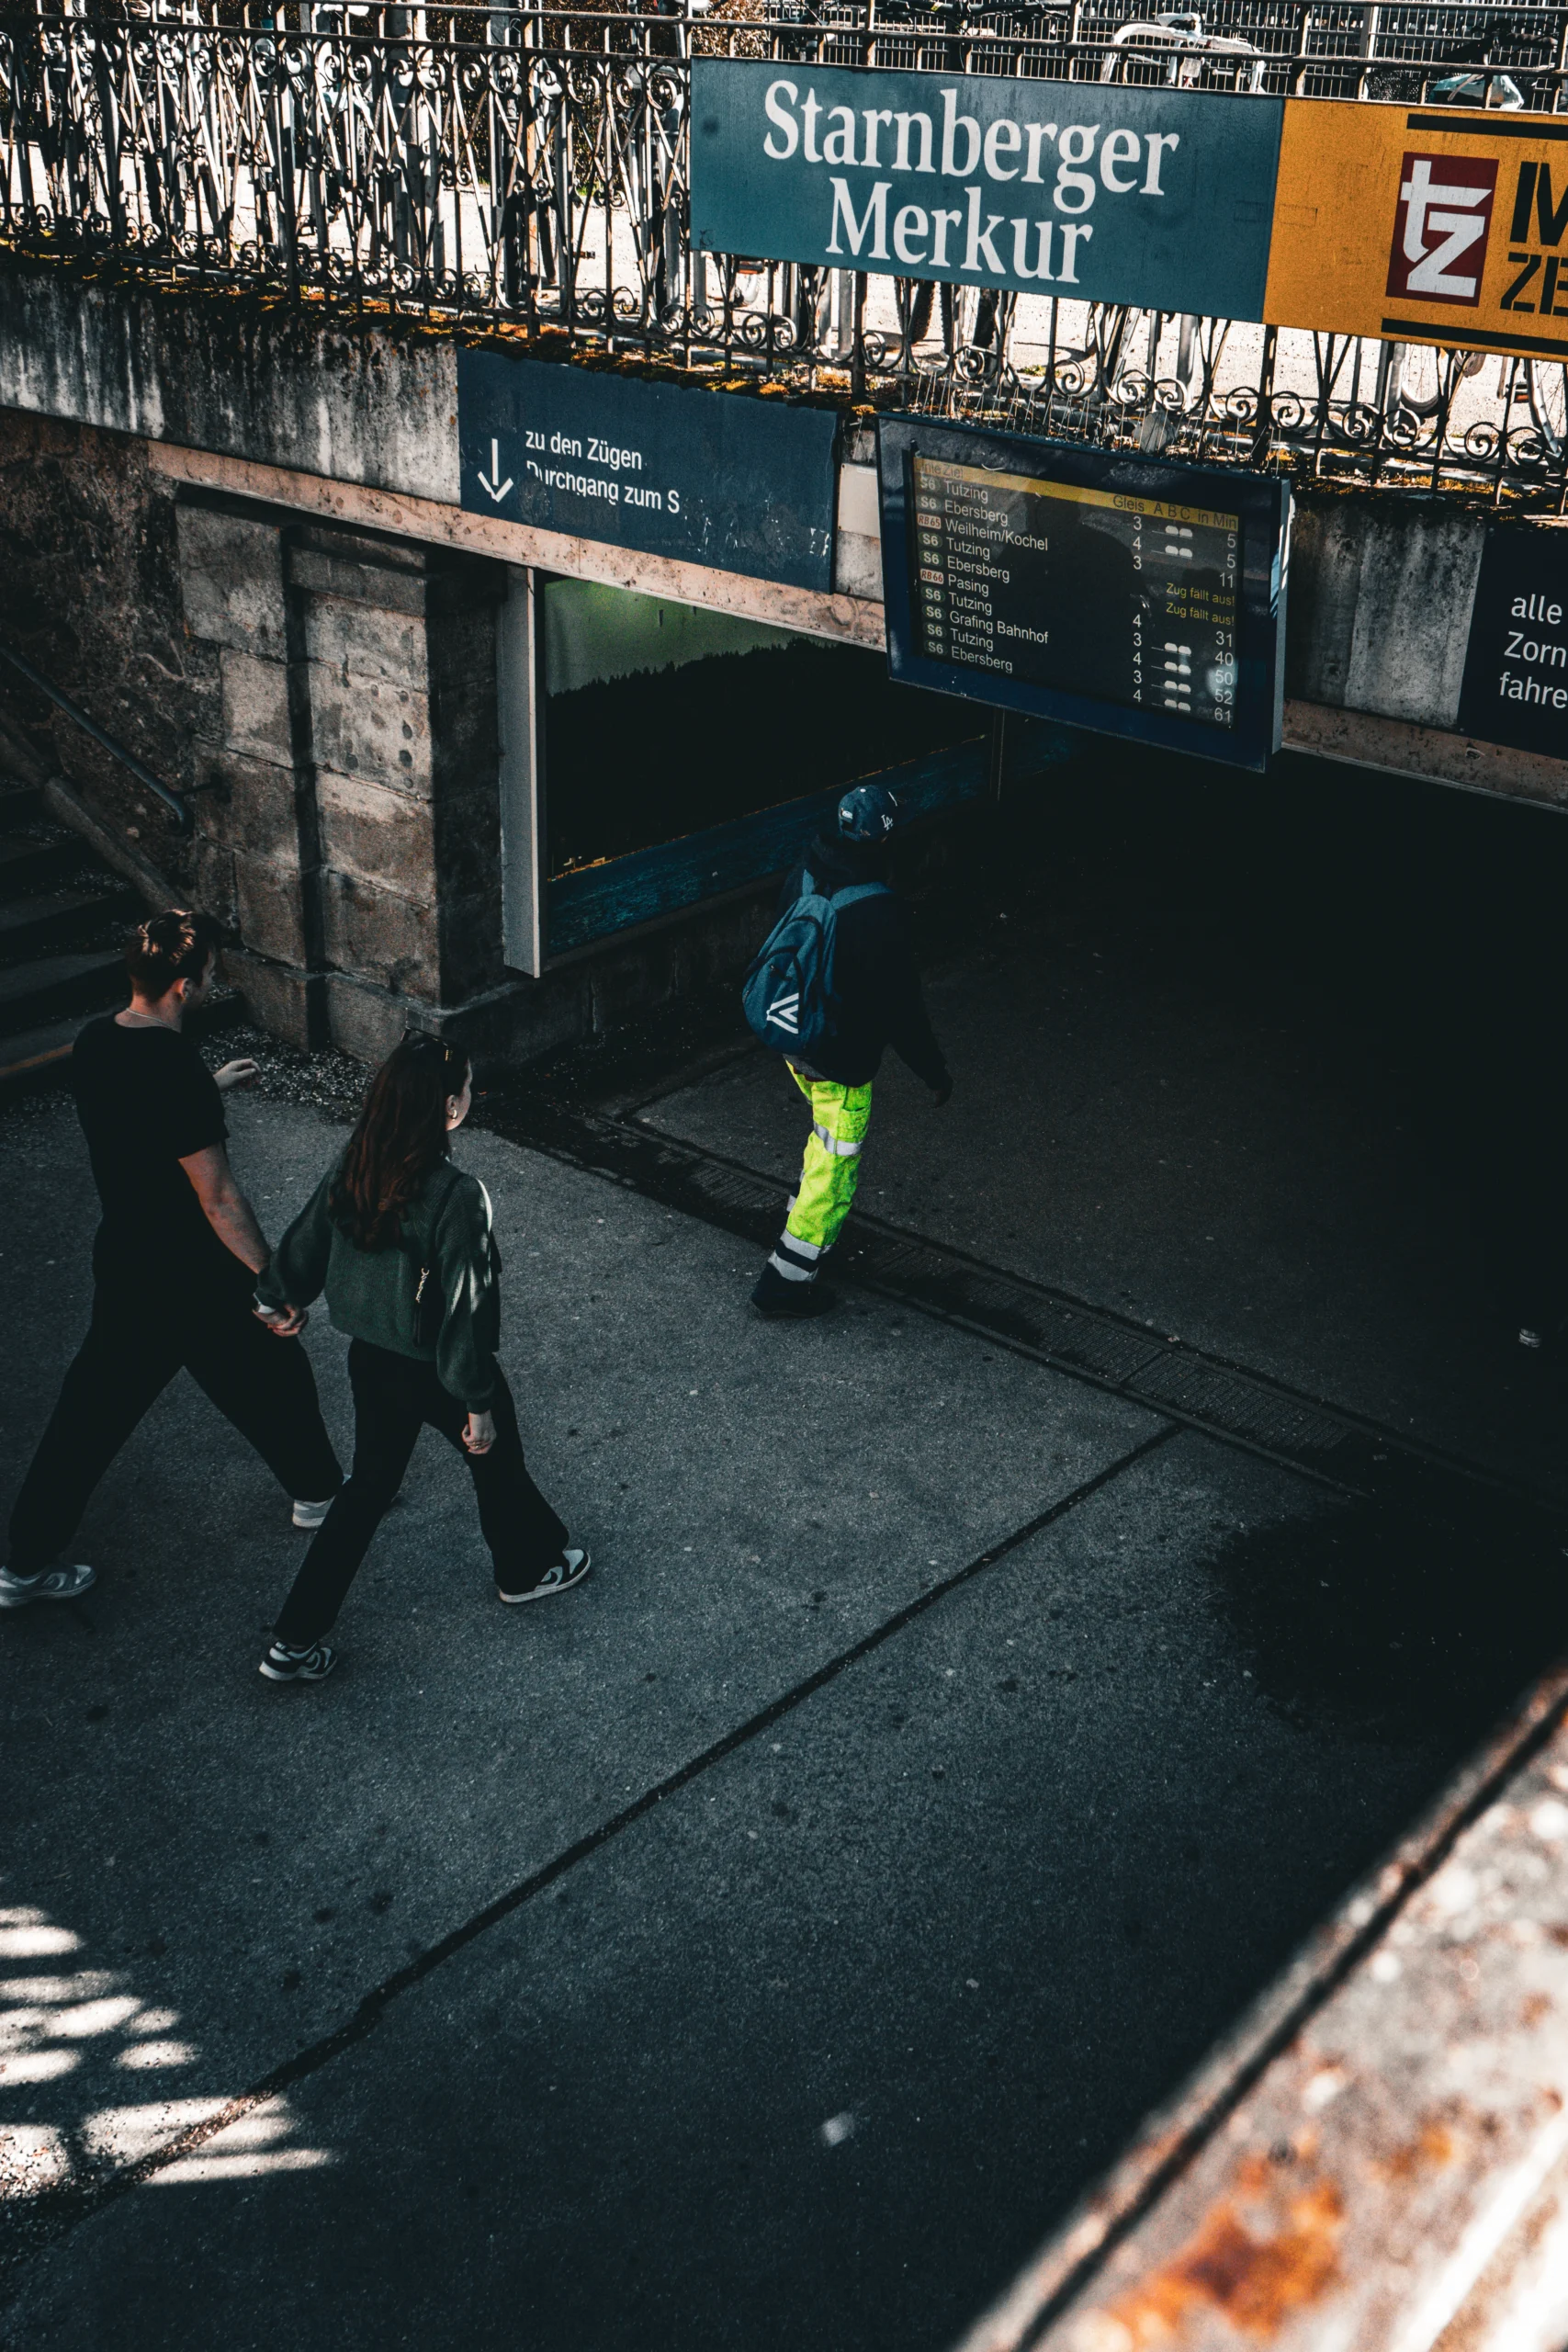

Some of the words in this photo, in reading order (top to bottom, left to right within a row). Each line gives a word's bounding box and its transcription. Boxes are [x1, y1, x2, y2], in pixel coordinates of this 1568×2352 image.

[763, 79, 1180, 214] Starnberger
[825, 177, 1094, 284] Merkur
[1400, 160, 1492, 298] tz
[525, 430, 545, 450] zu
[550, 431, 581, 458] den
[587, 437, 642, 470] Zügen
[624, 486, 661, 510] zum
[667, 490, 680, 514] S
[920, 477, 936, 491] S6
[944, 480, 988, 504] Tutzing
[1133, 515, 1143, 531] 3
[1226, 533, 1236, 548] 5
[920, 496, 937, 510] S6
[944, 499, 1009, 526] Ebersberg
[1133, 536, 1142, 550] 4
[1226, 553, 1236, 569] 5
[942, 462, 964, 479] Ziel
[1113, 495, 1145, 513] Gleis
[1153, 503, 1164, 515] A
[1168, 504, 1177, 518] B
[1179, 507, 1191, 520] C
[1198, 509, 1209, 523] in
[1213, 513, 1237, 530] Min
[922, 533, 939, 547] S6
[946, 537, 990, 560] Tutzing
[1166, 582, 1187, 599] Zug
[1190, 587, 1210, 602] fällt
[1212, 594, 1235, 607] aus!
[923, 551, 940, 565] S6
[947, 555, 1010, 583] Ebersberg
[1166, 602, 1187, 618] Zug
[1190, 607, 1209, 621] fällt
[1212, 613, 1235, 627] aus!
[945, 517, 1048, 551] Weilheim/Kochel
[1133, 555, 1143, 570] 3
[1219, 572, 1234, 589] 11
[925, 587, 942, 601] S6
[948, 591, 992, 616] Tutzing
[1133, 632, 1143, 647] 3
[1214, 650, 1235, 667] 40
[926, 605, 942, 619] S6
[949, 610, 993, 634] Grafing
[997, 620, 1049, 644] Bahnhof
[1133, 651, 1142, 666] 4
[1214, 669, 1235, 686] 50
[948, 573, 989, 597] Pasing
[1133, 614, 1142, 628] 4
[1215, 630, 1233, 648] 31
[1511, 594, 1562, 625] alle
[927, 624, 943, 638] S6
[950, 628, 994, 652] Tutzing
[1133, 670, 1143, 684] 3
[1214, 688, 1234, 706] 52
[928, 641, 944, 655] S6
[951, 645, 1013, 673] Ebersberg
[1133, 689, 1142, 703] 4
[1213, 707, 1231, 723] 61
[1504, 630, 1567, 668] Zorn
[1499, 672, 1568, 709] fahre
[881, 814, 894, 831] LA
